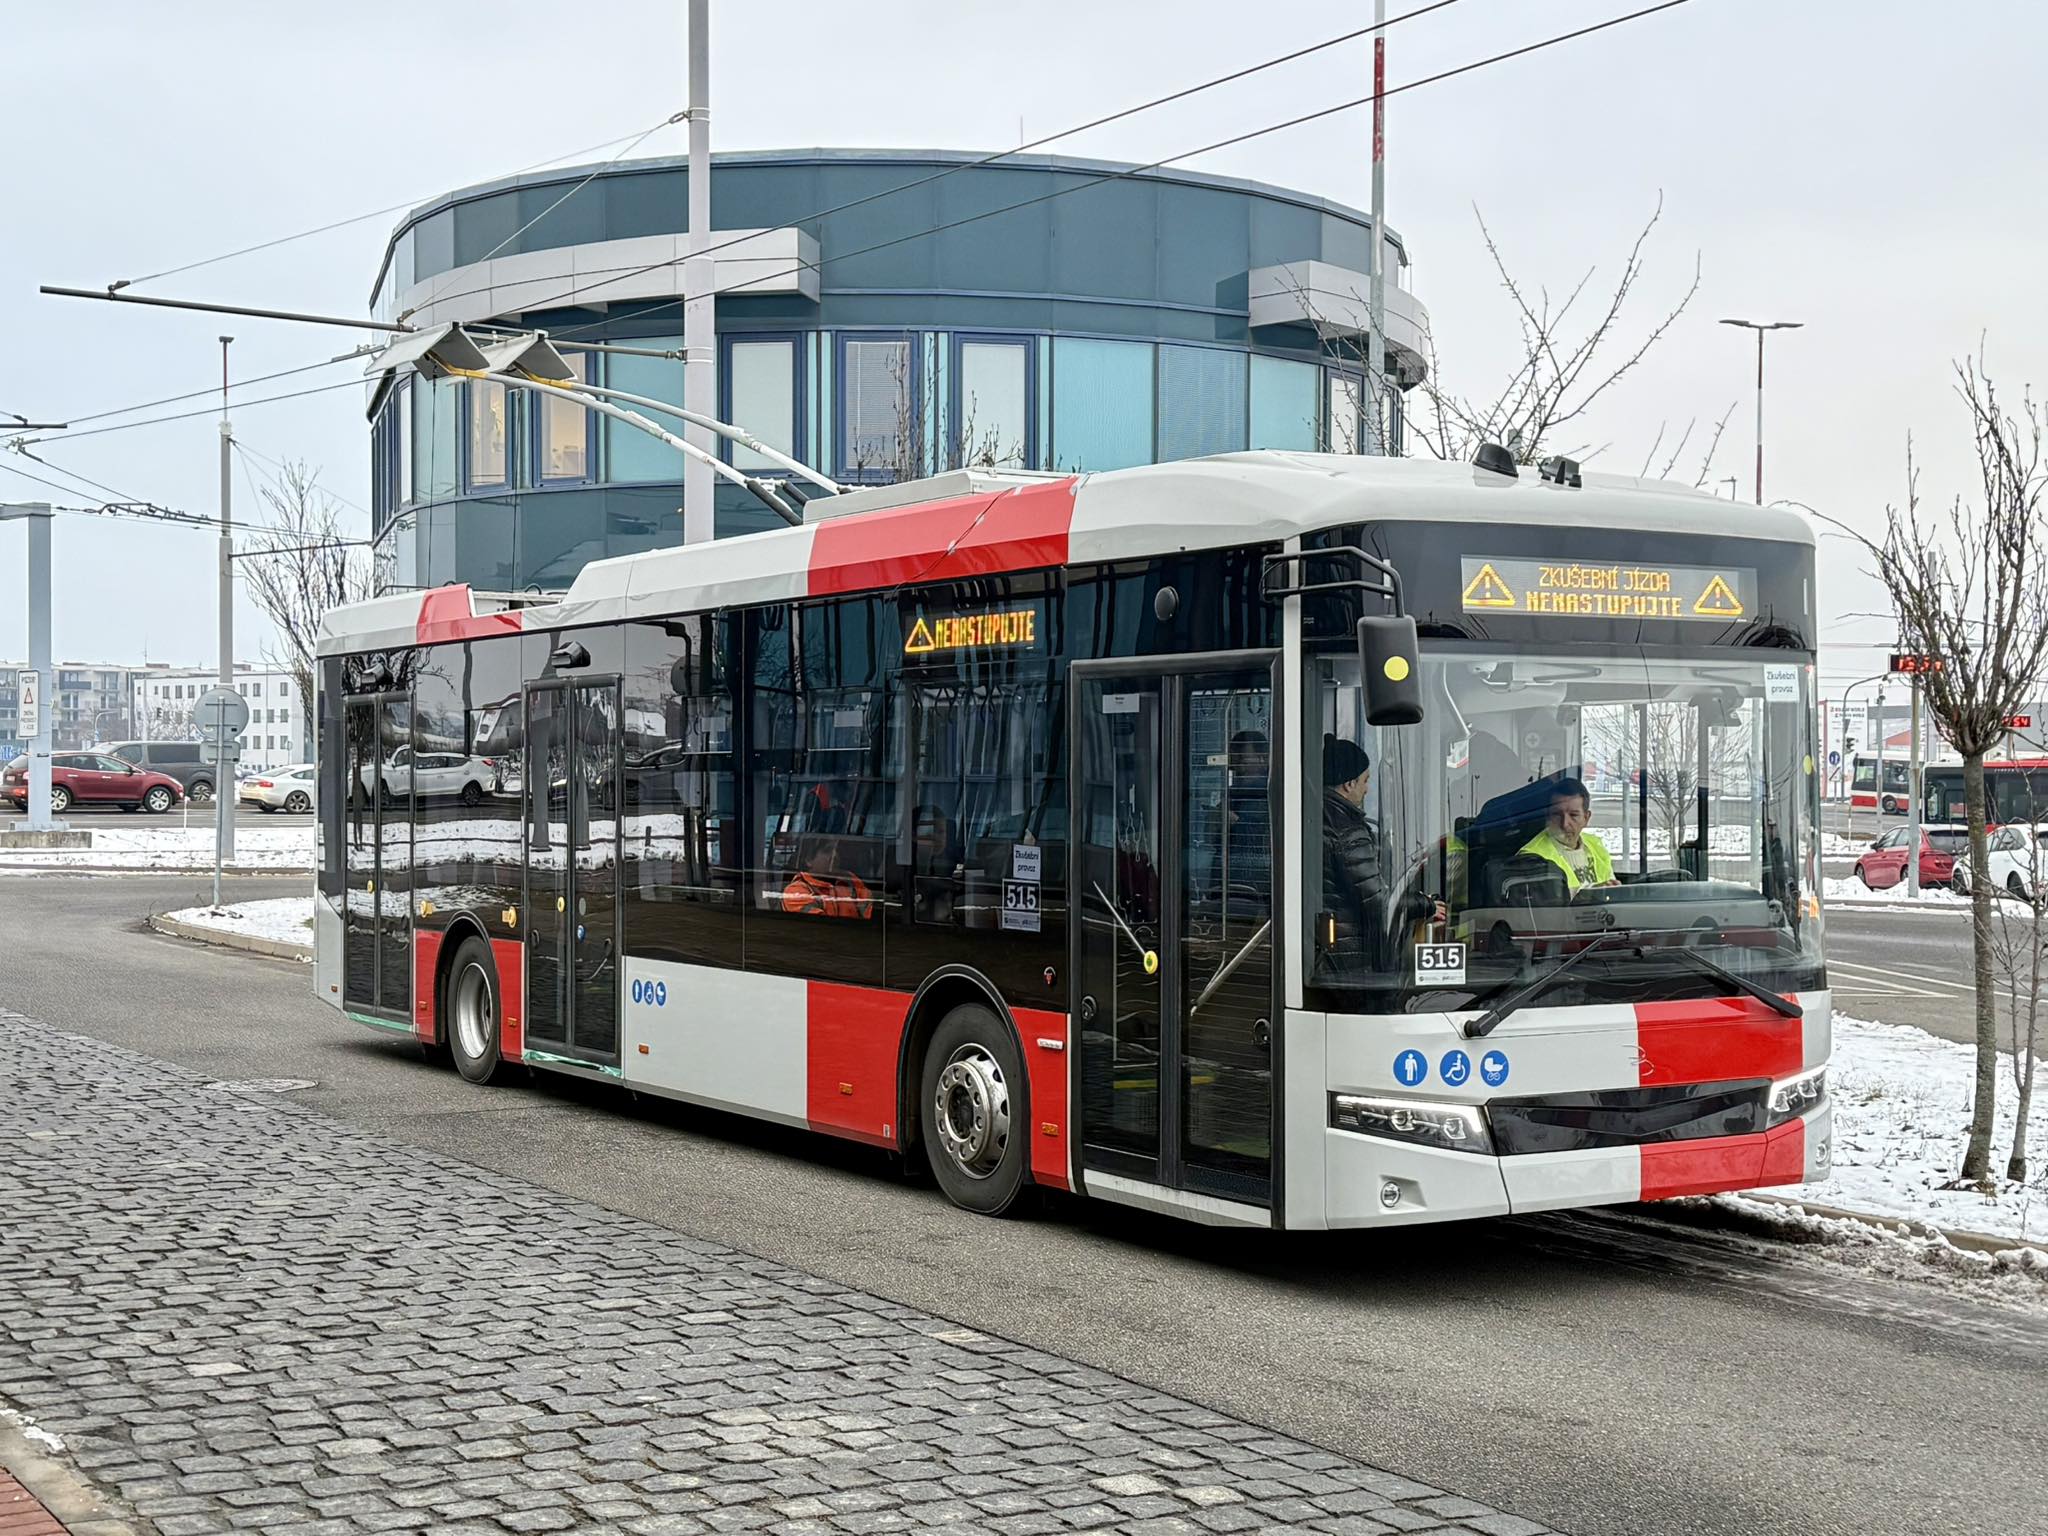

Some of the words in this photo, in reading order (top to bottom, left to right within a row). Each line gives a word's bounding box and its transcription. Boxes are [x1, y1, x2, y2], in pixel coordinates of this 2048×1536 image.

[1538, 563, 1619, 590] ZKUŠEBNÍ
[1623, 566, 1671, 592] JÍZDA
[1525, 591, 1683, 617] NENASTUPUJTE
[935, 610, 1036, 649] NENASTUPUJTE
[1771, 686, 1793, 695] provoz
[1006, 884, 1037, 910] 515
[1422, 948, 1459, 968] 515
